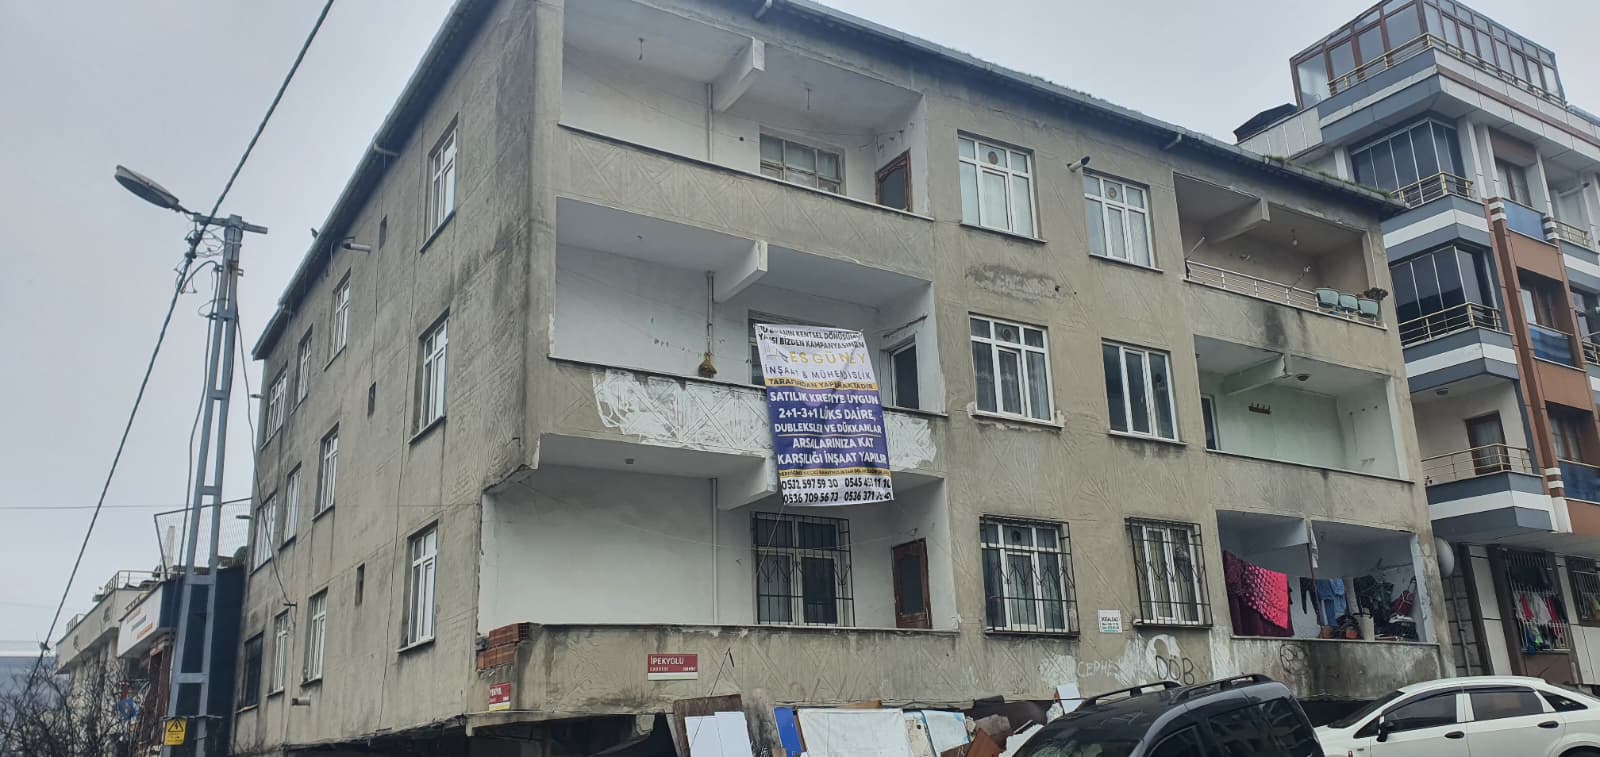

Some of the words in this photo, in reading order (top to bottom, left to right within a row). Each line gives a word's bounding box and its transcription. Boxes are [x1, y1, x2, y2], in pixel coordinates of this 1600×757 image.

[770, 391, 809, 402] SATILIK
[848, 394, 879, 405] UYGUN
[778, 407, 818, 418] 2+1-3+1
[844, 407, 876, 421] DAİRE,
[824, 424, 836, 433] VE
[837, 421, 882, 434] DÜKKANLAR
[858, 437, 874, 448] KAT
[777, 451, 824, 466] KARŞILIĞI
[824, 450, 857, 466] İNŞAAT
[859, 451, 887, 464] YAPILIR
[802, 479, 816, 488] 597
[817, 479, 826, 489] 59
[828, 479, 838, 488] 30
[844, 478, 863, 488] 0545
[784, 493, 801, 504] 0536
[804, 492, 819, 503] 709
[820, 492, 829, 502] 56
[830, 491, 839, 502] 73
[844, 491, 862, 502] 0536
[863, 490, 875, 501] 371
[650, 655, 684, 665] İPEKYOLU
